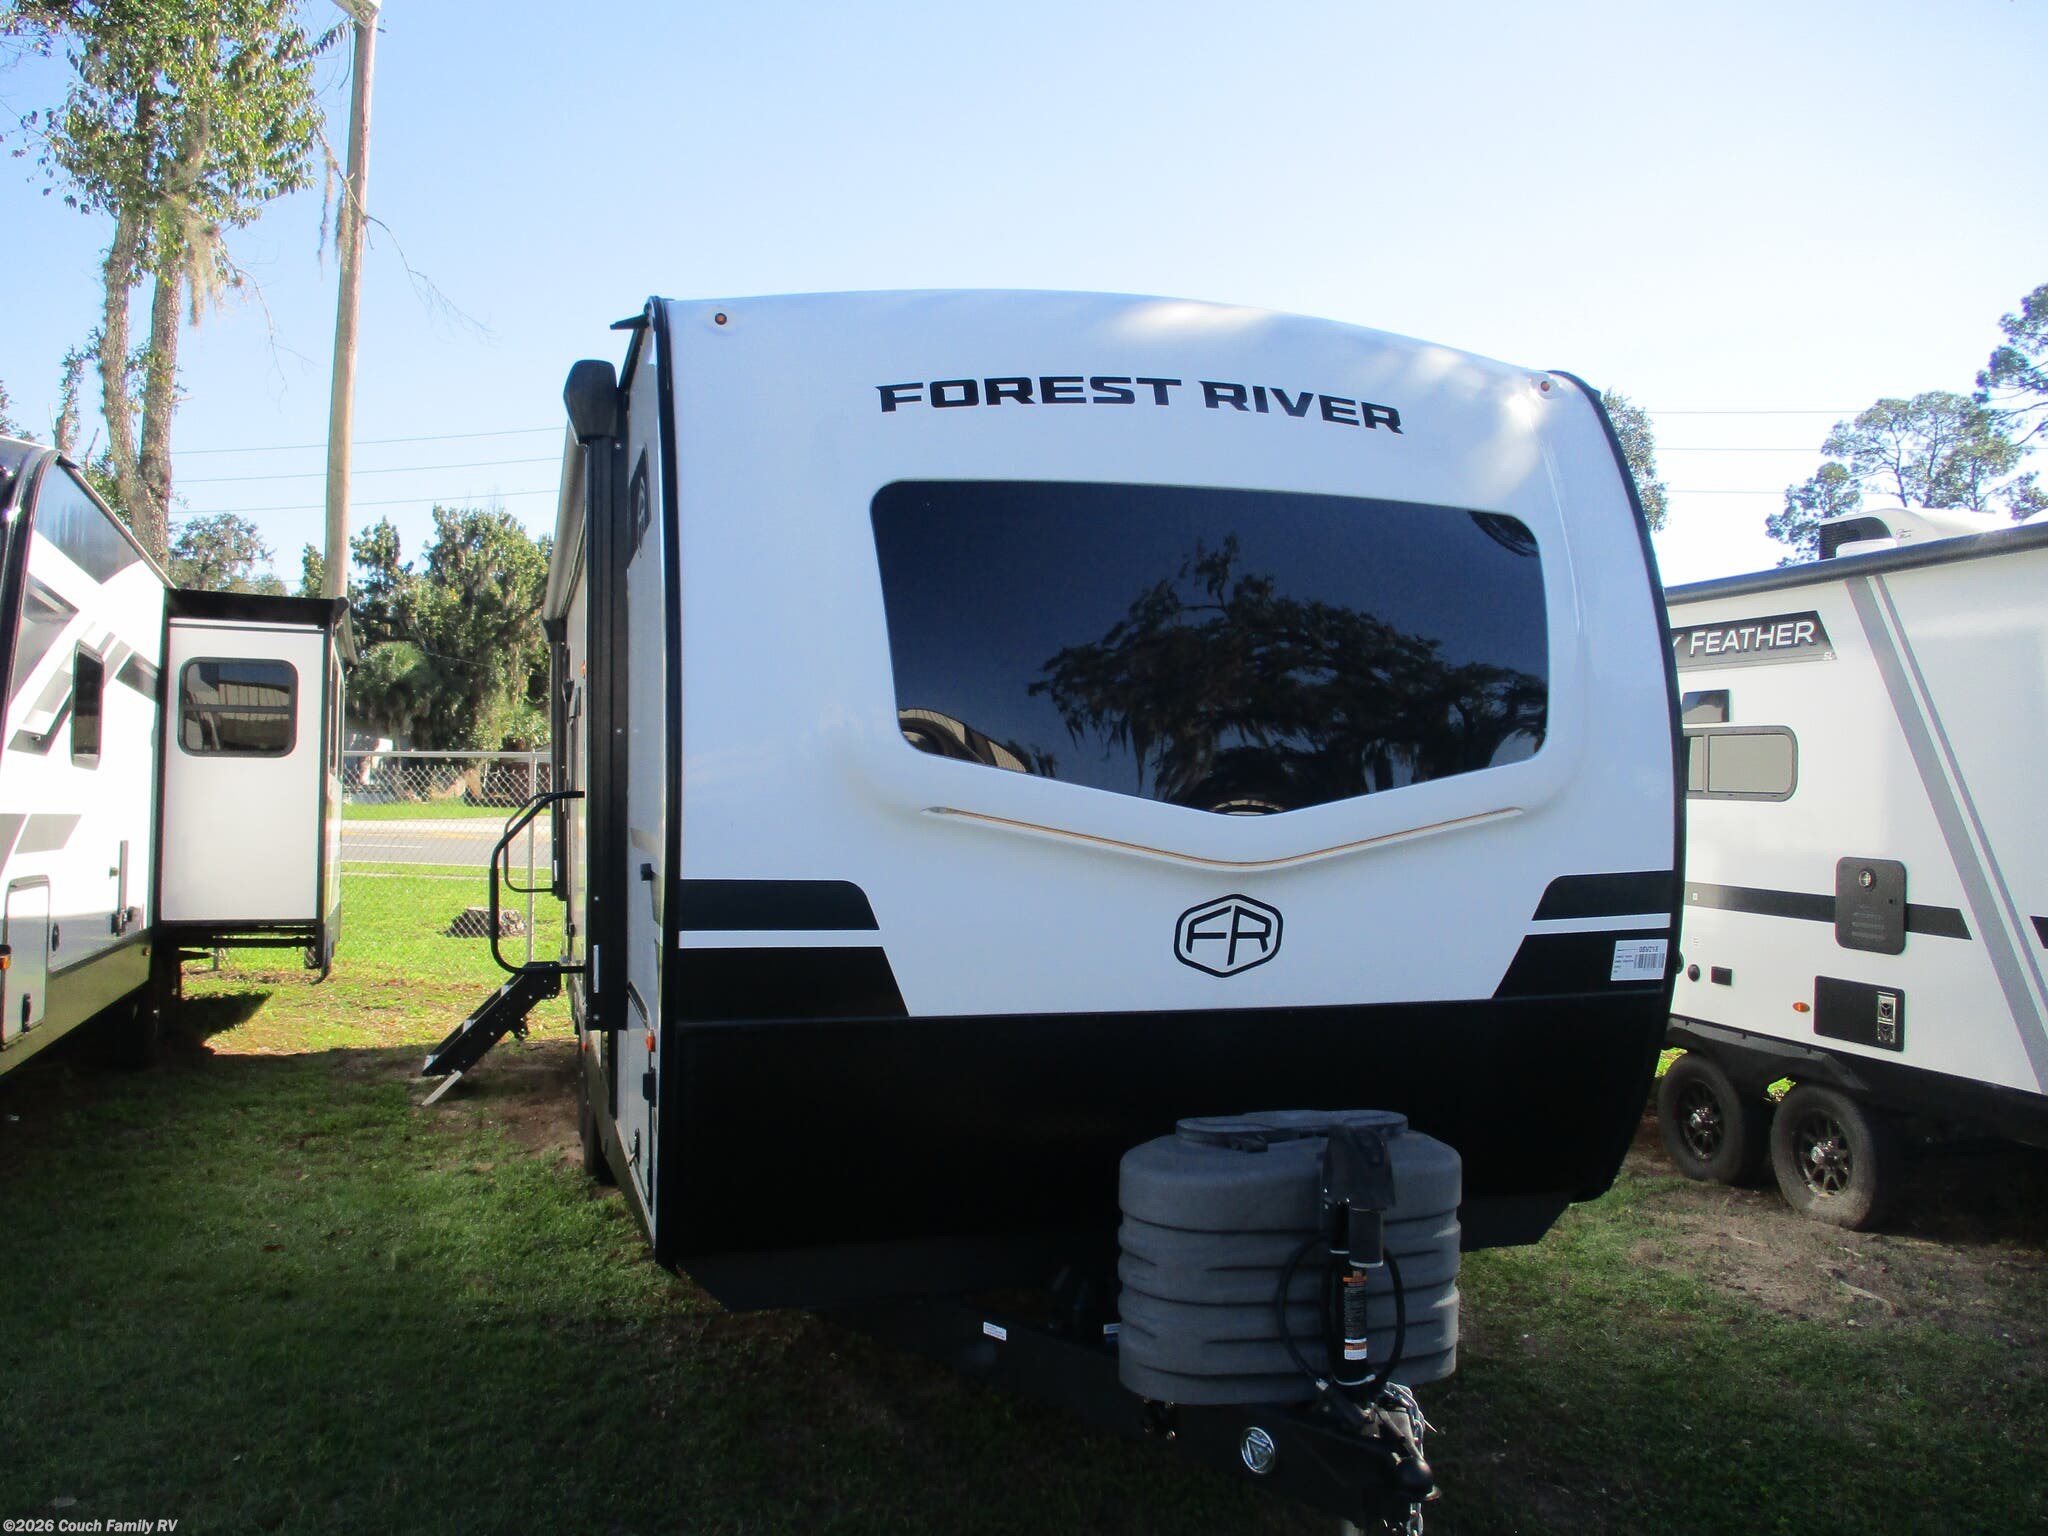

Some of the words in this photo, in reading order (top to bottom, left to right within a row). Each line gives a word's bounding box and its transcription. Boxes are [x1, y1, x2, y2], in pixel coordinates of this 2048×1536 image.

[875, 376, 1182, 413] FOREST
[1198, 380, 1404, 435] RIVER
[1689, 621, 1816, 656] FEATHER
